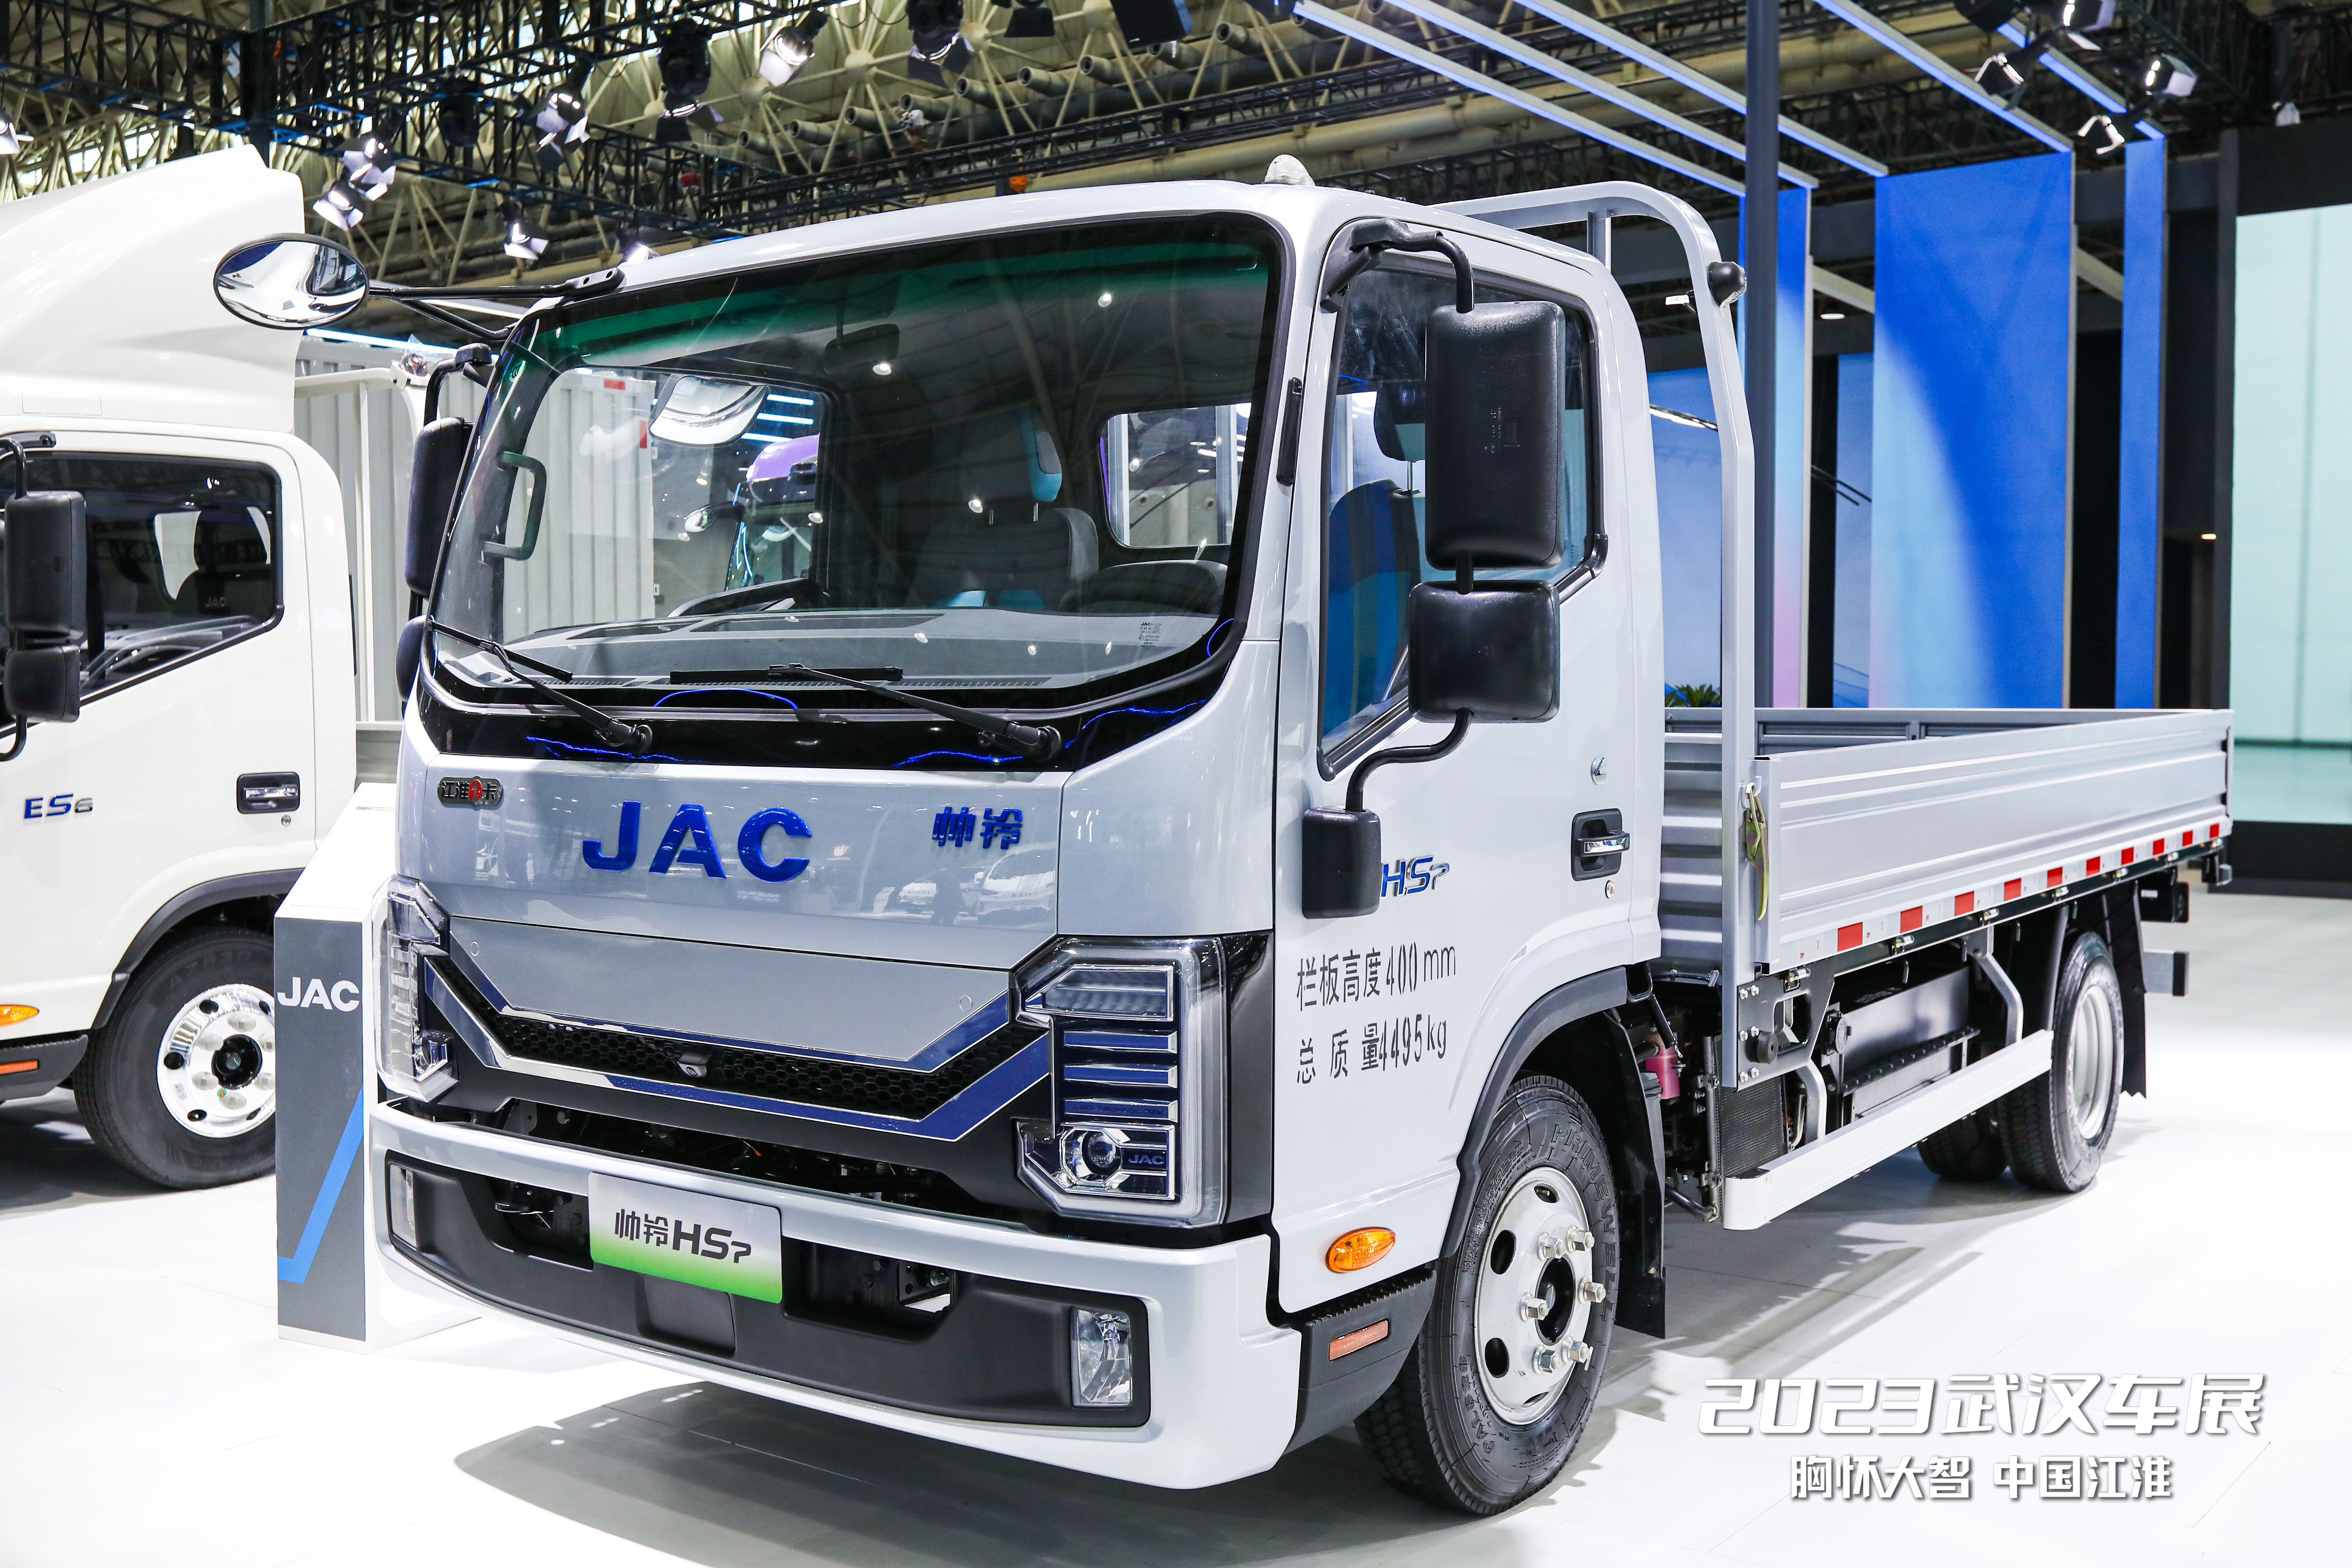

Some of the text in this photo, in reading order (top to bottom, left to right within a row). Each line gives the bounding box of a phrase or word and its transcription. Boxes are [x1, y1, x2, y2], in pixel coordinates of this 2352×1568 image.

[204, 596, 227, 607] JAC
[582, 800, 812, 883] JAC
[932, 806, 1023, 850] 帅铃
[277, 976, 360, 1012] JAC
[1128, 1154, 1165, 1165] JAC
[1551, 1124, 1617, 1321] PRIMEWELL
